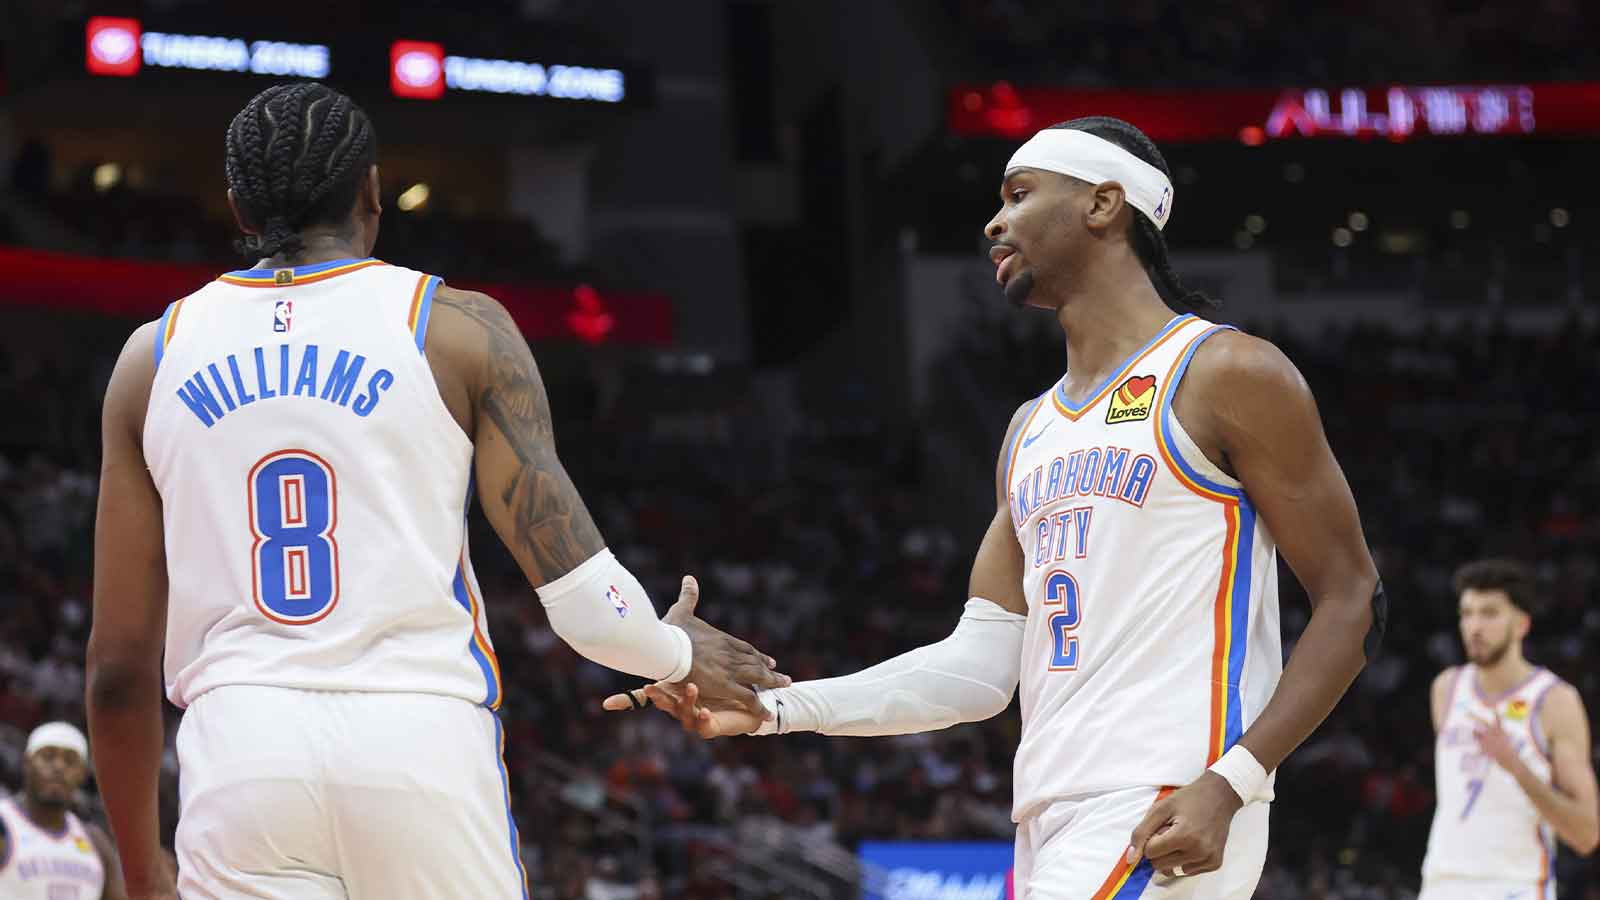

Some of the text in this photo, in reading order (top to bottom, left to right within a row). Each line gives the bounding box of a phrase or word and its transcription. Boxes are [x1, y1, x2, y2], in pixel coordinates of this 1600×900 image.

[176, 344, 394, 428] WILLIAMS
[247, 448, 340, 626] 8
[1034, 506, 1093, 568] CITY
[1044, 569, 1081, 671] 2
[1460, 778, 1484, 824] 7
